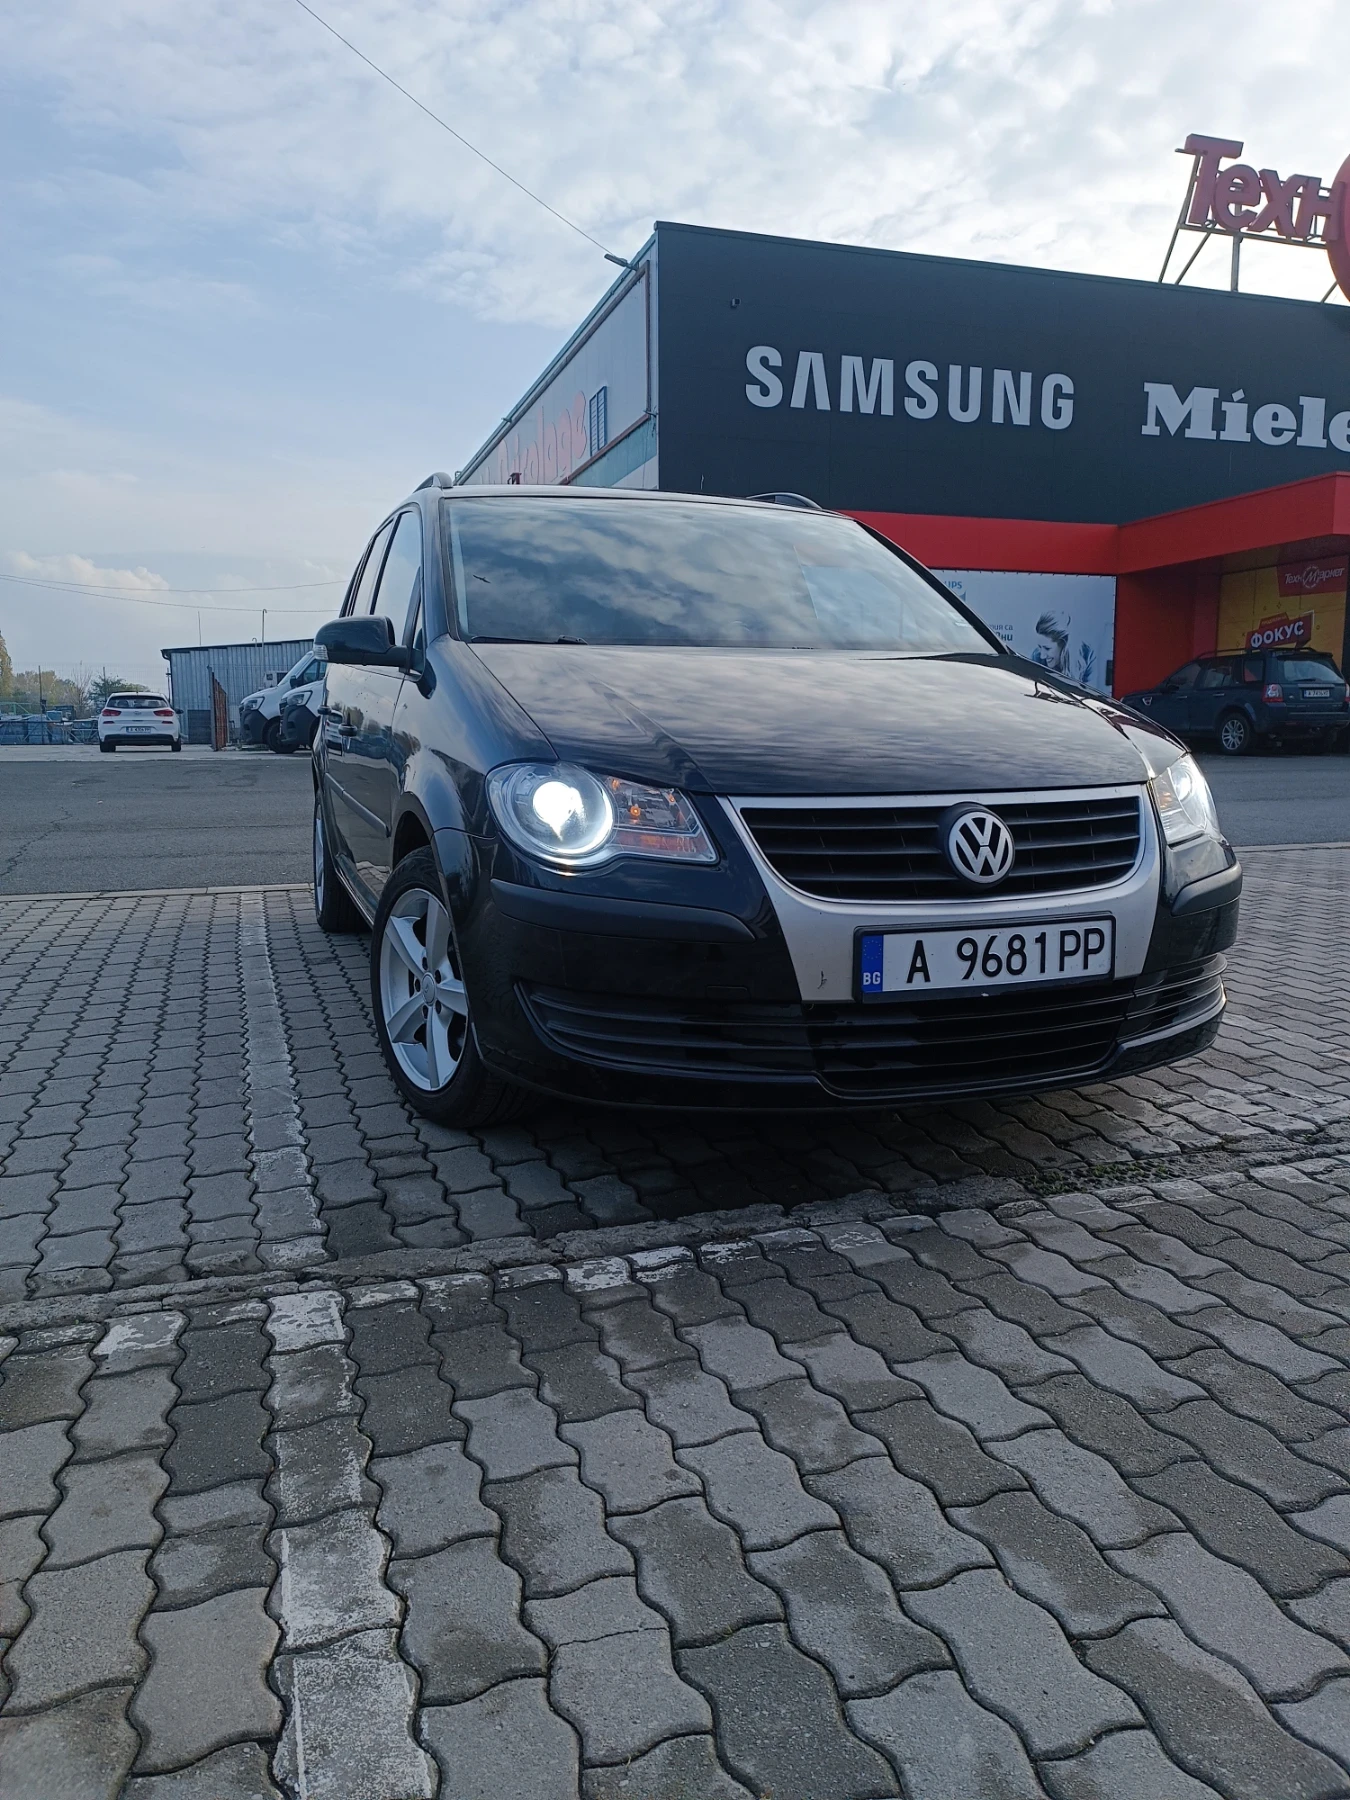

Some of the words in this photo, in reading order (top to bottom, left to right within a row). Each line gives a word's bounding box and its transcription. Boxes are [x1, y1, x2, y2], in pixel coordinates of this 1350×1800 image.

[746, 346, 1074, 430] SAMSUNG
[1250, 621, 1304, 648] ФОКУС
[863, 971, 882, 986] BG
[906, 940, 931, 984] A
